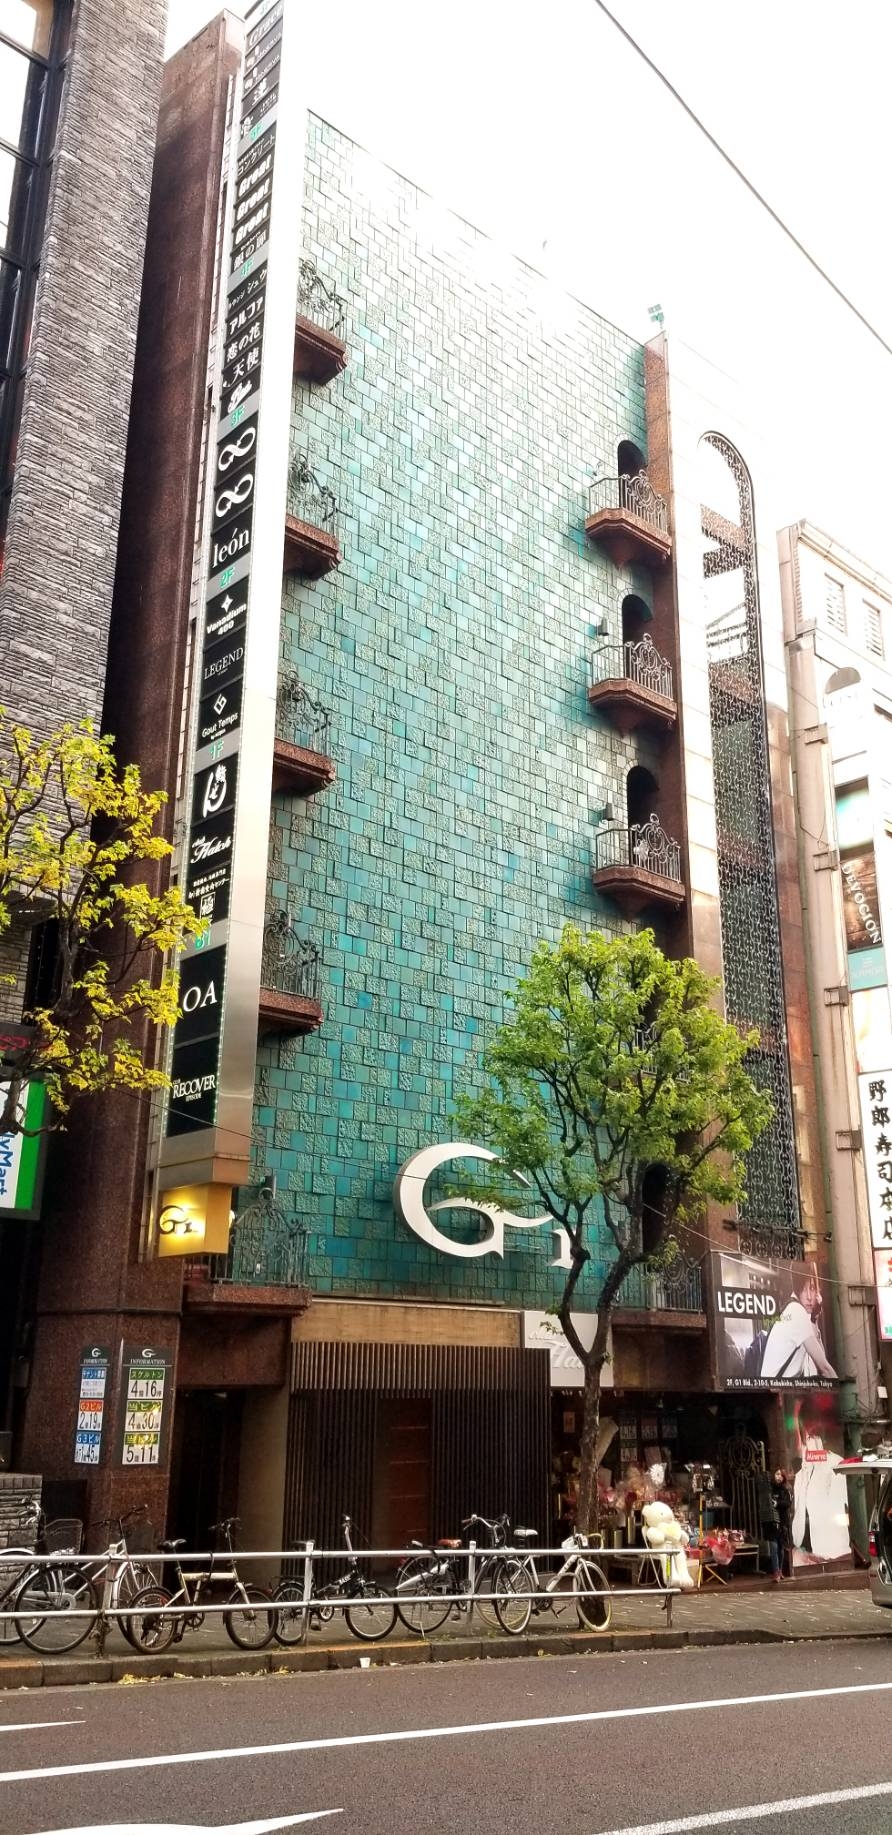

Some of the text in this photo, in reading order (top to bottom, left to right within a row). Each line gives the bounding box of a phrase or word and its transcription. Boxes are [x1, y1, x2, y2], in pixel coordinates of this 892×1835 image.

[229, 296, 264, 335] アルファ
[226, 322, 260, 363] 恋の花
[226, 346, 260, 386] 天使
[231, 404, 245, 428] 3F
[212, 527, 250, 569] león
[220, 566, 236, 589] 2F
[206, 603, 247, 634] Vanadium
[204, 647, 244, 680] LEGEND
[201, 723, 218, 738] Gout
[217, 712, 239, 728] Temps
[208, 738, 225, 761] 1F
[183, 980, 218, 1013] OA
[172, 1074, 216, 1099] RECOVER
[717, 1290, 776, 1316] LEGEND
[131, 1370, 163, 1379] スケルトン
[80, 1401, 102, 1411] G2ビル
[127, 1401, 161, 1412] 当ビル
[76, 1432, 100, 1443] G3ビル
